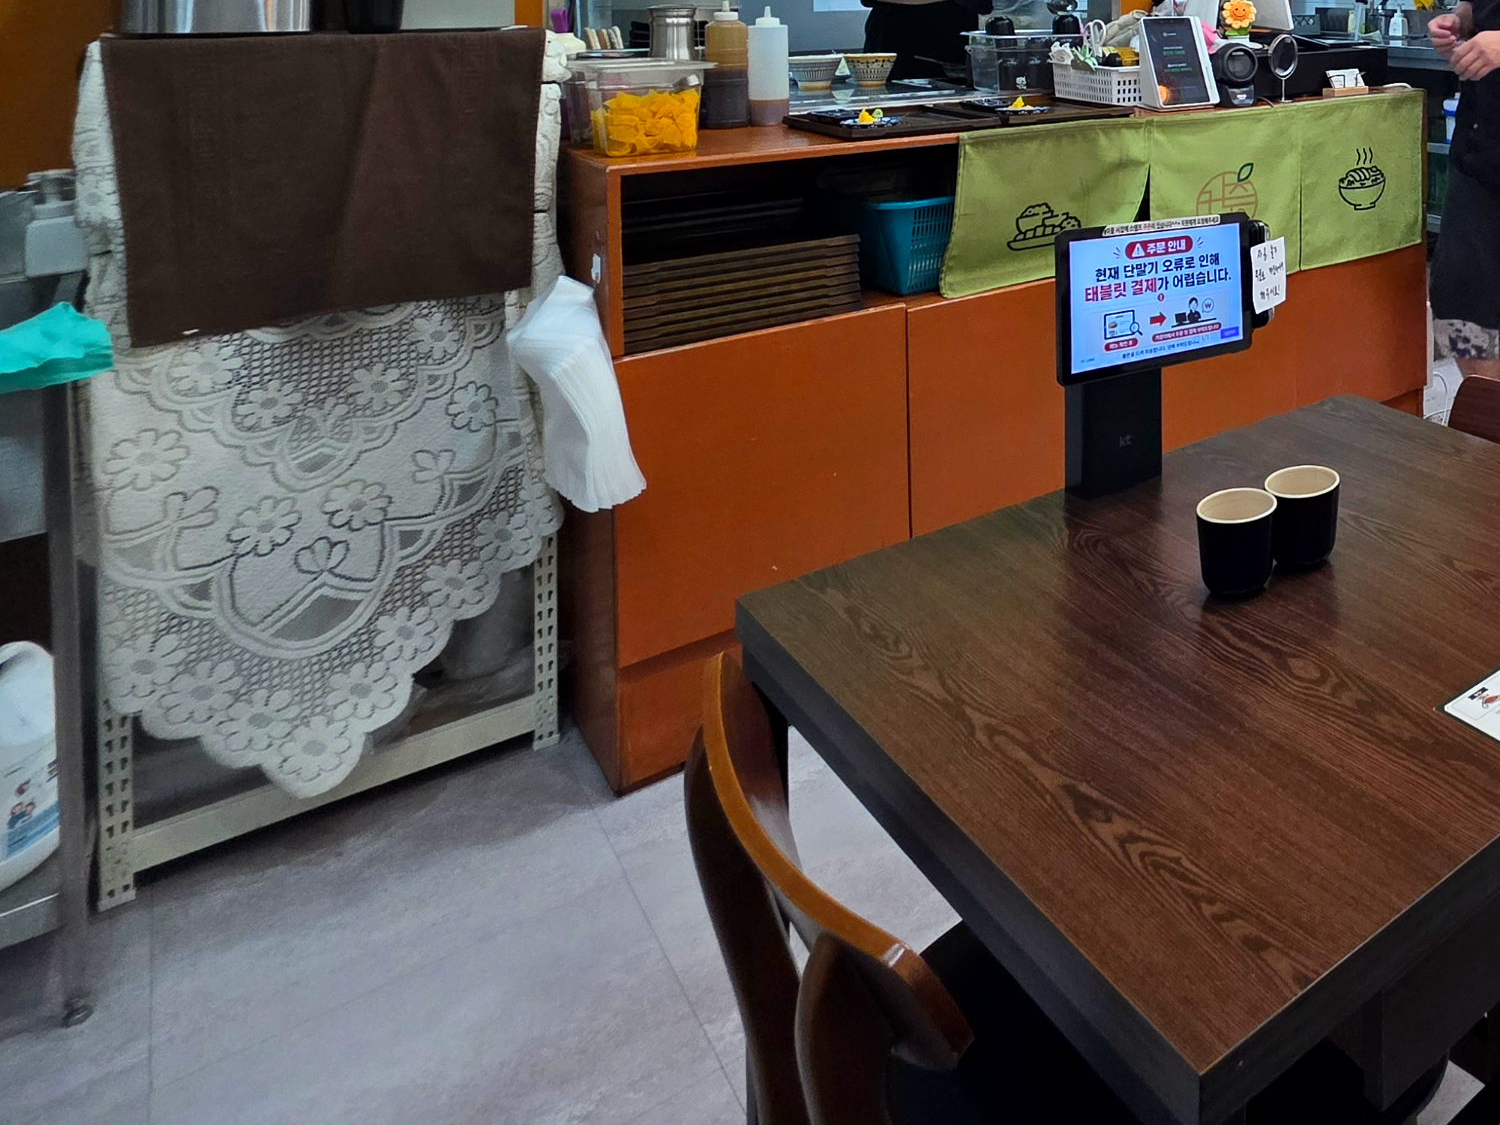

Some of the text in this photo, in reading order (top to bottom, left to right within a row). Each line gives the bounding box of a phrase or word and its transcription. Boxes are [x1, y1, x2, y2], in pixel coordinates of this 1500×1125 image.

[1147, 239, 1186, 254] 주문 안내
[1095, 253, 1220, 282] 현재 단말기 오류로 인해
[1085, 268, 1232, 302] 태블릿 결제가 어렵습니다.
